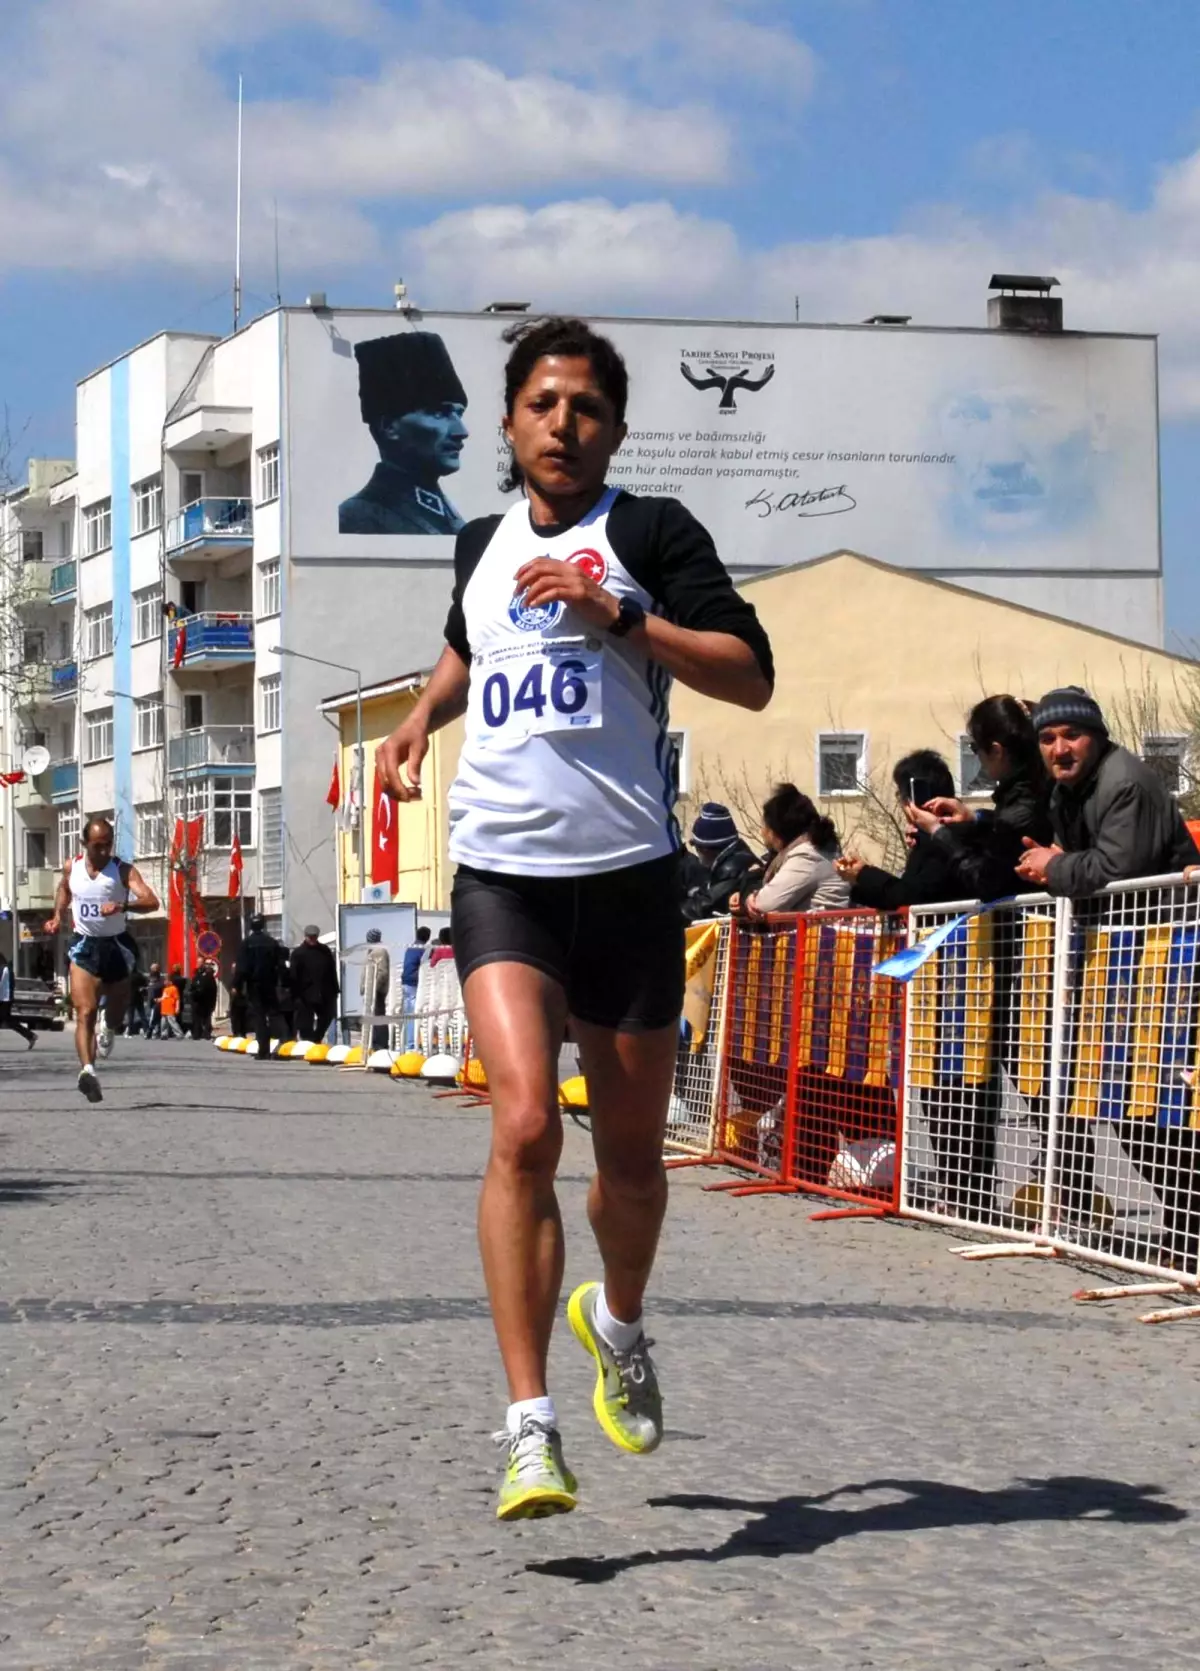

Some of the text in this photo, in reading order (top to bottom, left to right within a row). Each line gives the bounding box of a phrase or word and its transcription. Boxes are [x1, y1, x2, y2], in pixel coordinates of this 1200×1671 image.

[678, 432, 692, 441] ve
[637, 446, 676, 460] koşulu
[679, 447, 717, 459] olarak
[720, 448, 752, 460] kabul
[756, 448, 789, 462] etmiş
[792, 452, 824, 461] cesur
[826, 450, 885, 463] insanların
[659, 464, 713, 477] olmadan
[482, 660, 588, 728] 046
[80, 903, 99, 917] 03
